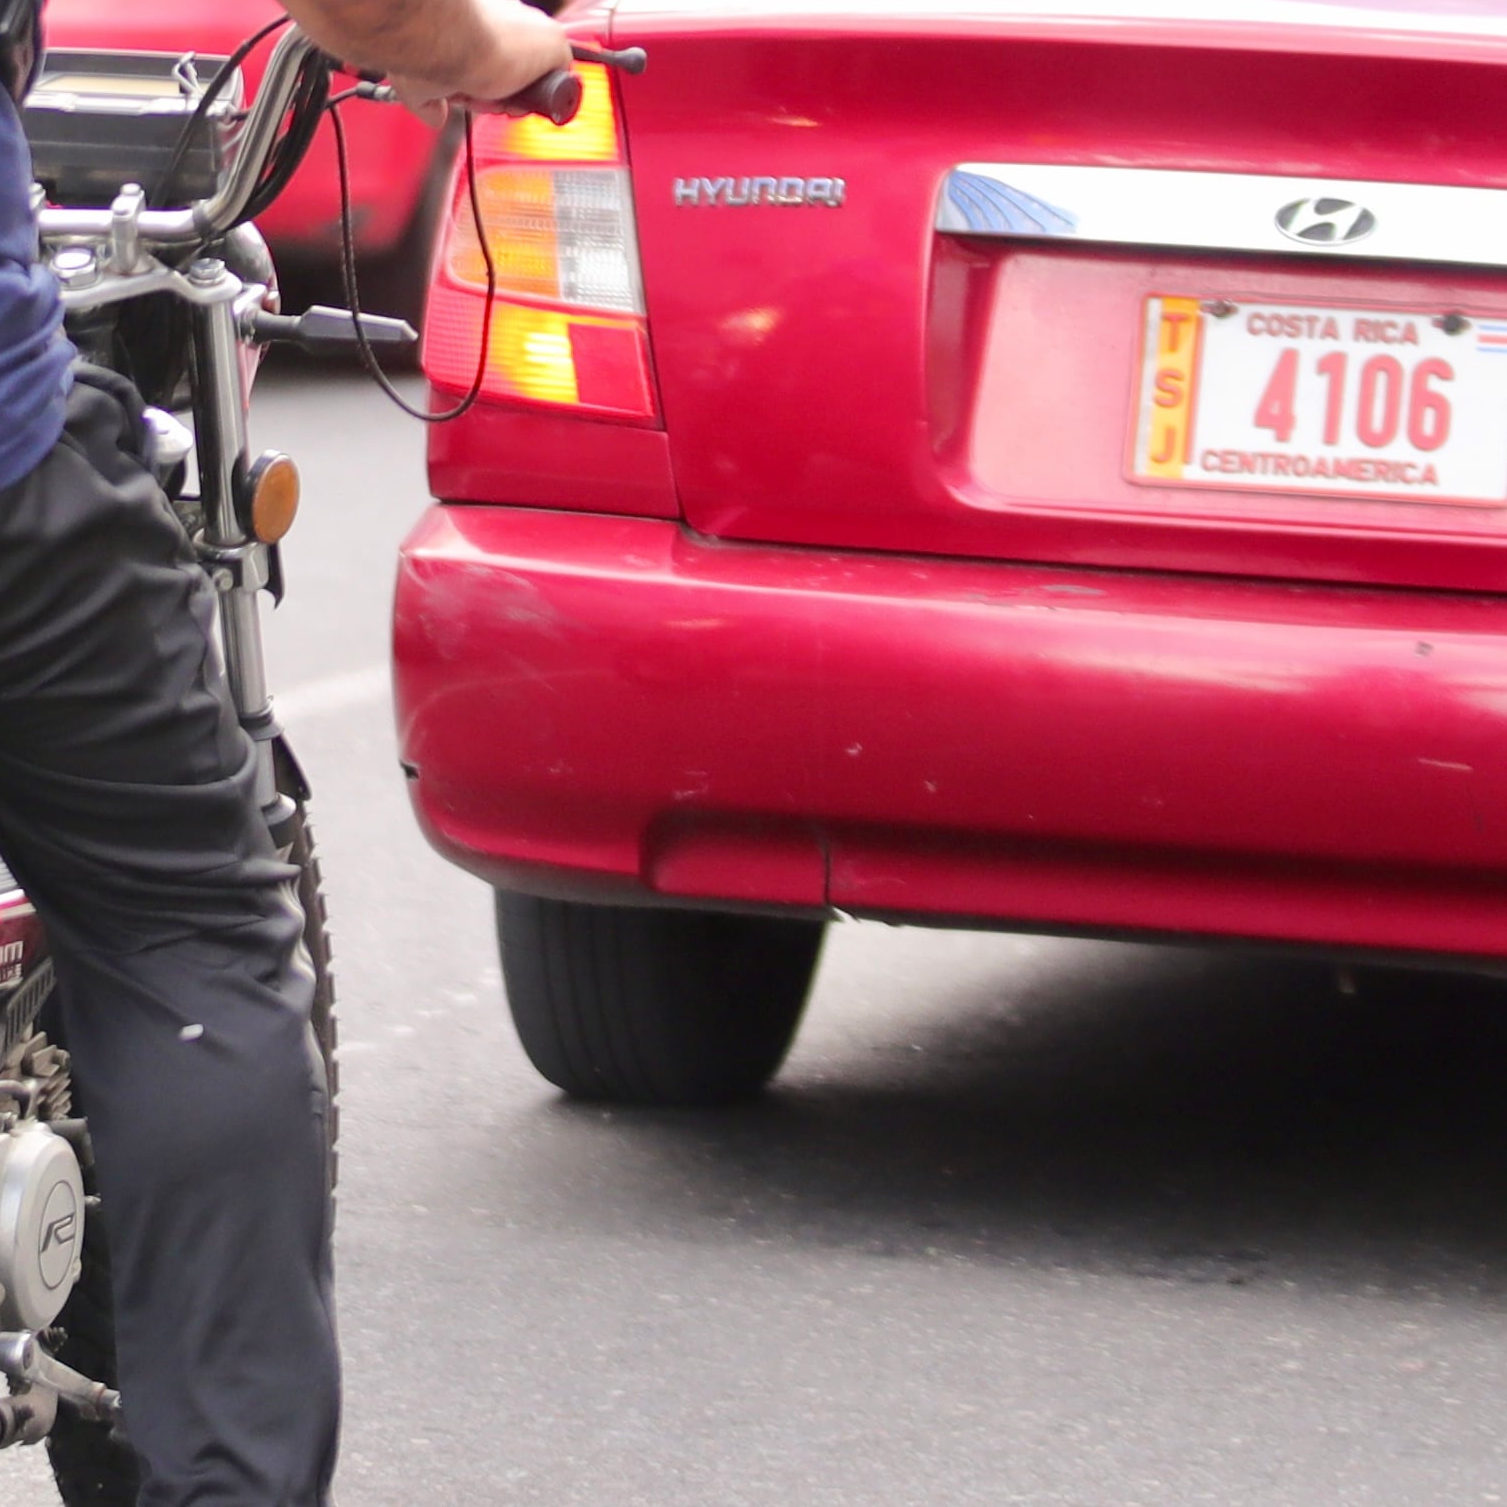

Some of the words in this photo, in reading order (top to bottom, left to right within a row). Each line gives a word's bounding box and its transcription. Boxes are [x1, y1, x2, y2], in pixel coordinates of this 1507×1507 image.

[674, 176, 845, 208] HYUNDAI
[1245, 311, 1340, 343] COSTA
[1353, 316, 1420, 346] RICA
[1253, 347, 1455, 453] 4106
[1200, 448, 1440, 486] CENTROAMERICA
